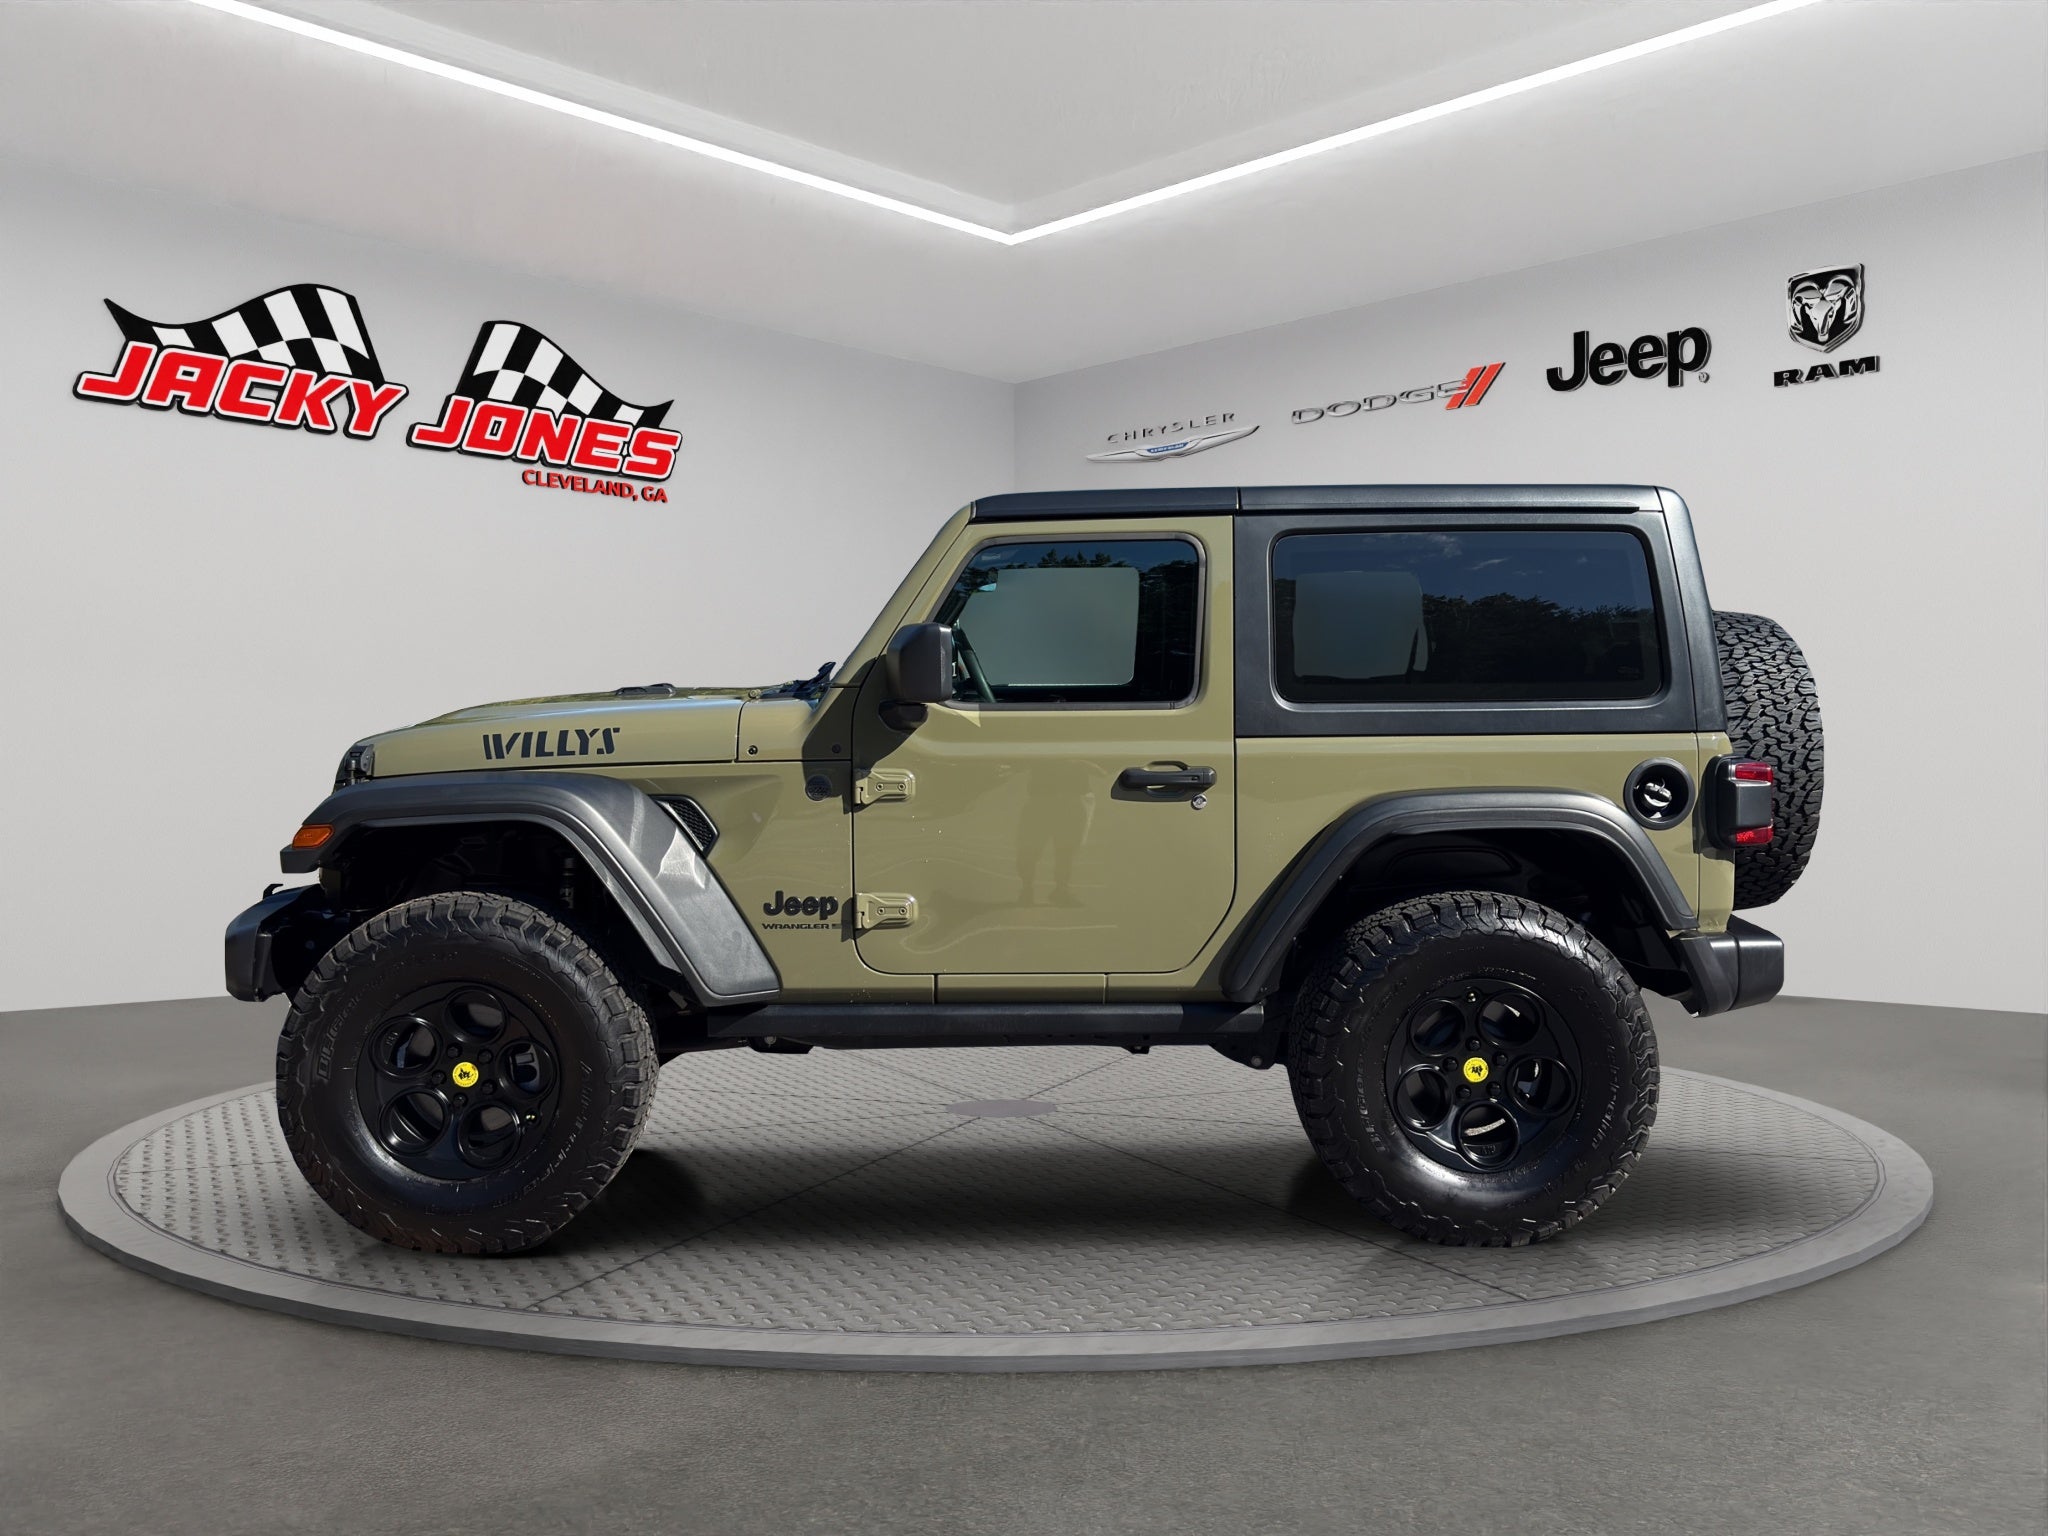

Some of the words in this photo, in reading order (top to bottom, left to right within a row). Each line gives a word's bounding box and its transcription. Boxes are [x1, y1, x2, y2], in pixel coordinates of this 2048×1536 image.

[1546, 327, 1712, 391] Jeep
[1774, 355, 1881, 387] RAM
[73, 340, 408, 440] JACKY
[408, 393, 682, 482] JONES
[1292, 379, 1468, 424] DODGE
[1107, 413, 1235, 443] CHRYSLER
[522, 469, 638, 501] CLEVELAND,
[641, 486, 668, 503] GA
[482, 727, 620, 760] WILLYS
[763, 890, 838, 920] Jeep
